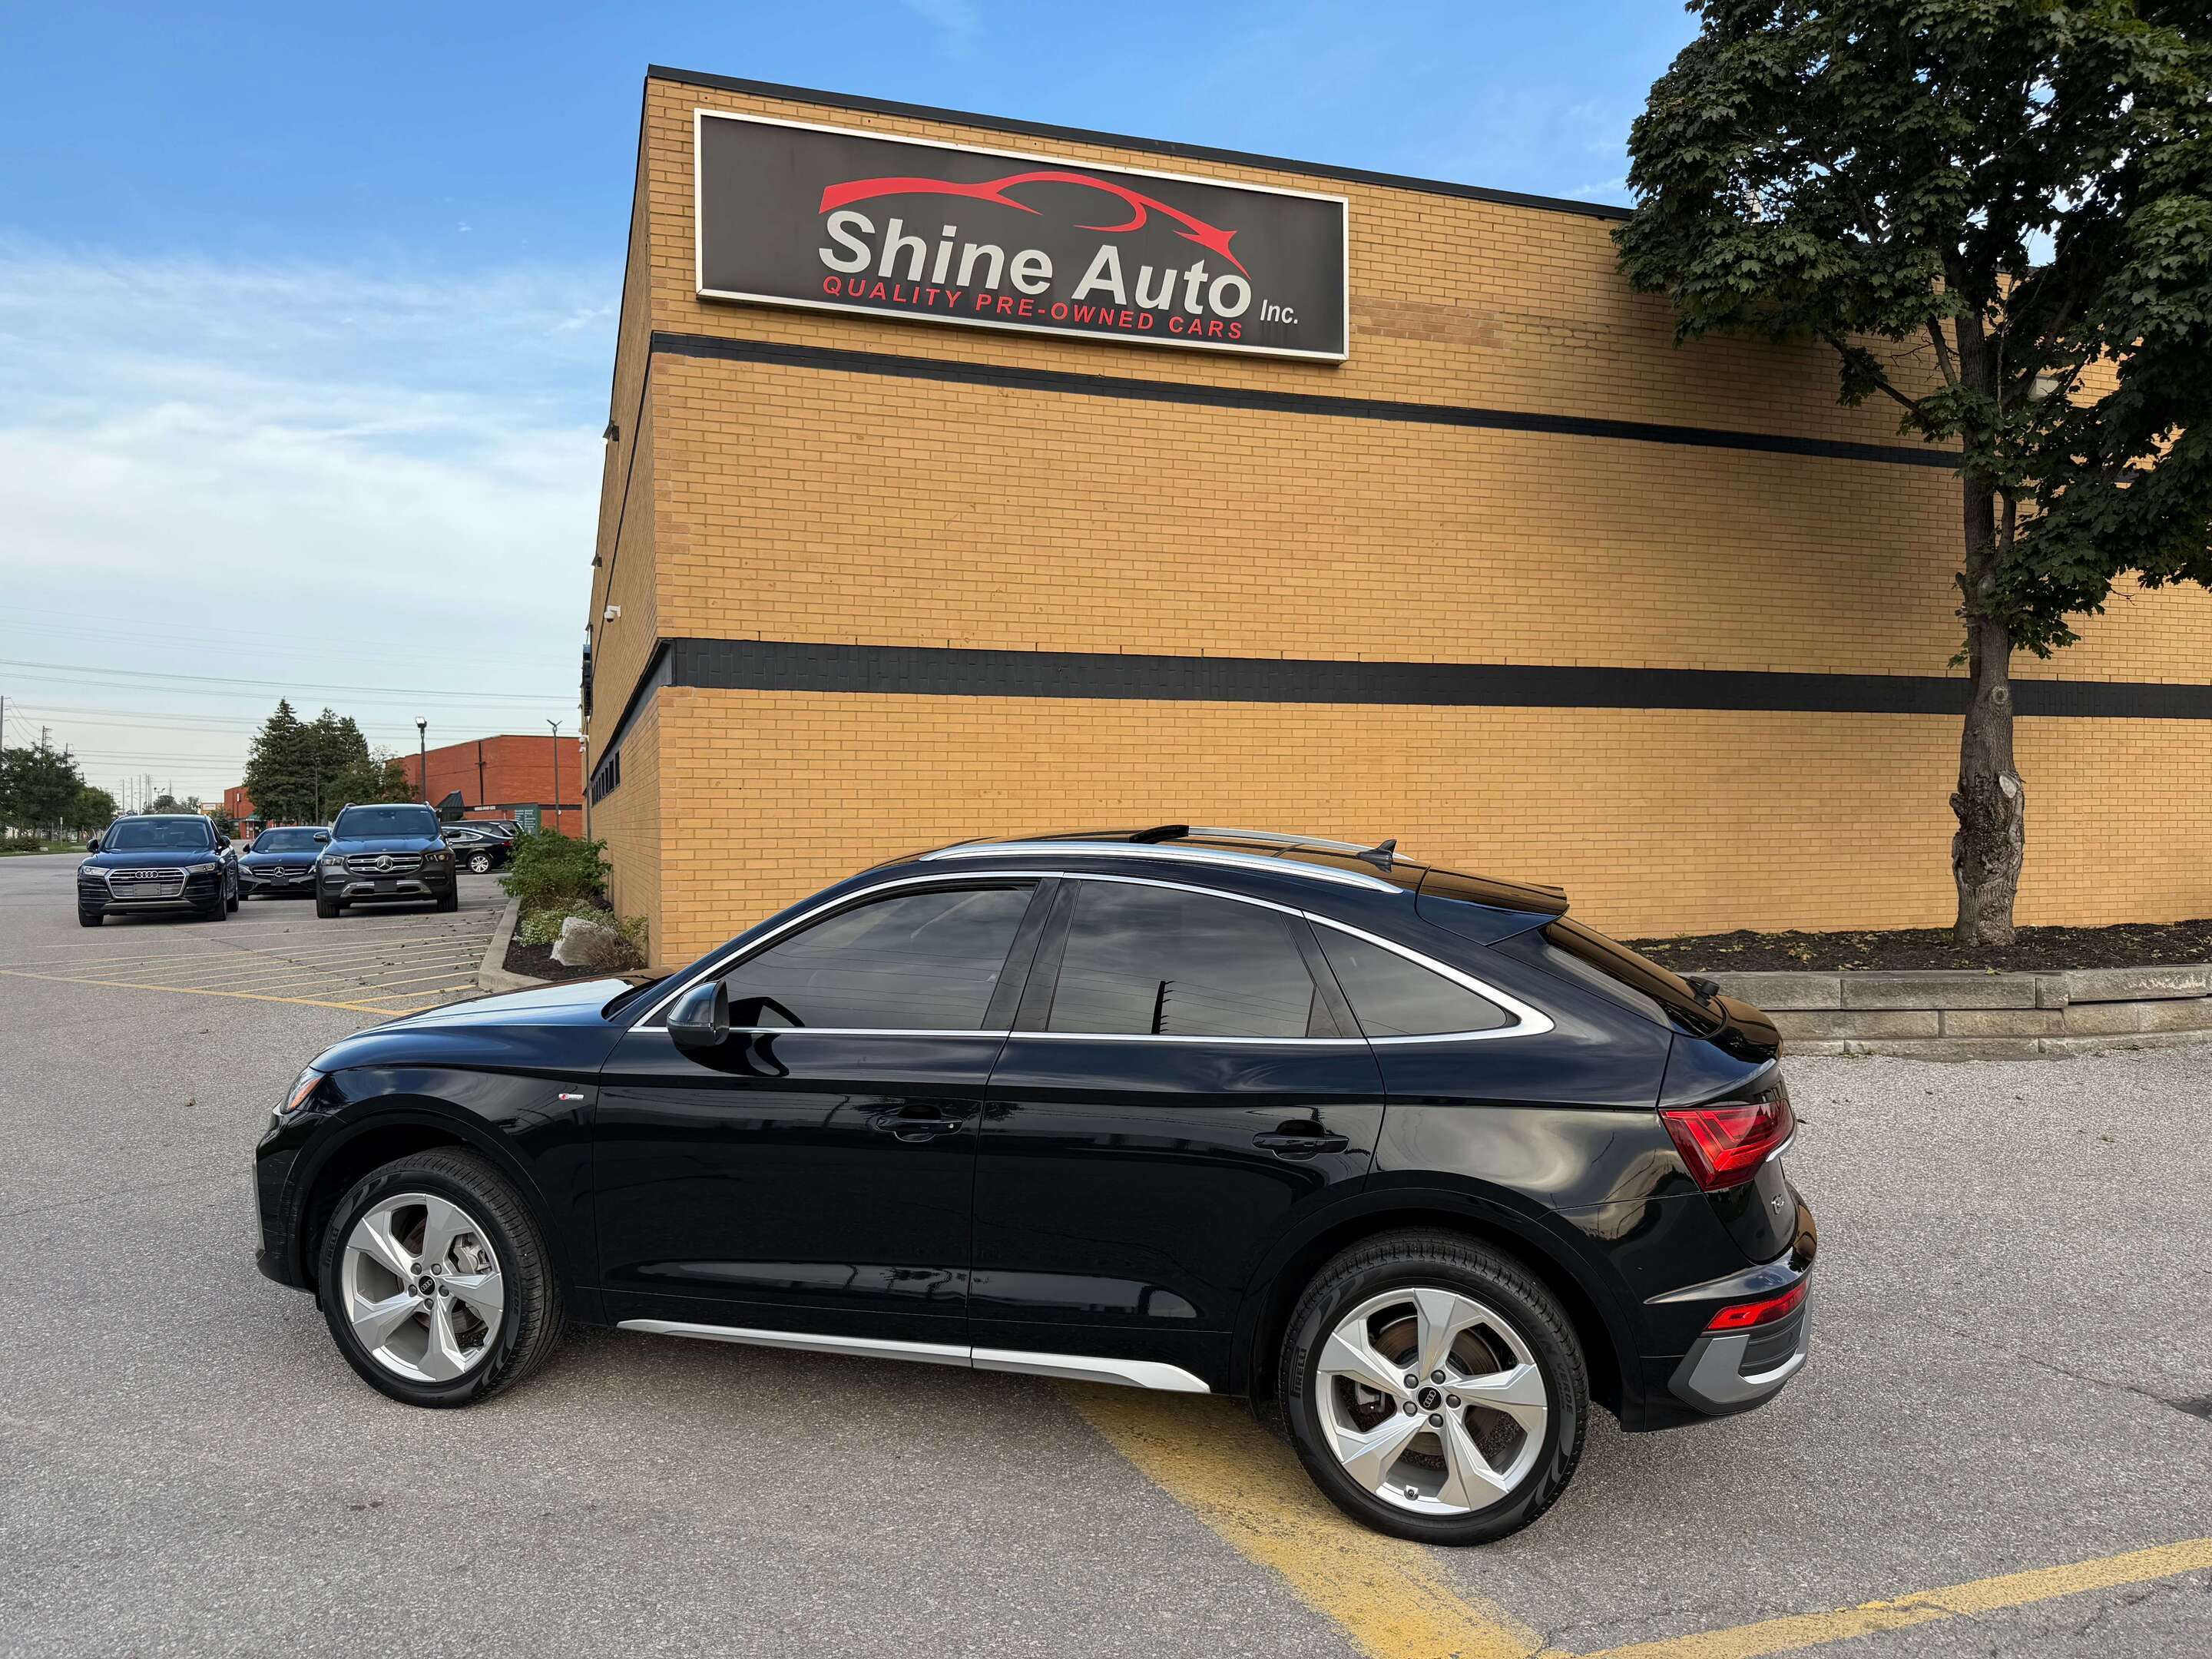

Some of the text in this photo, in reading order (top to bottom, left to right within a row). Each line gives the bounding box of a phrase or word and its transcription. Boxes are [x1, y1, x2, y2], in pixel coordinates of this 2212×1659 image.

[819, 210, 1298, 324] Shine Auto Inc.
[823, 276, 1242, 339] QUALITY PRE-OWNED CARS
[1290, 1346, 1306, 1399] PIRELLI
[1557, 1363, 1574, 1415] VERDE
